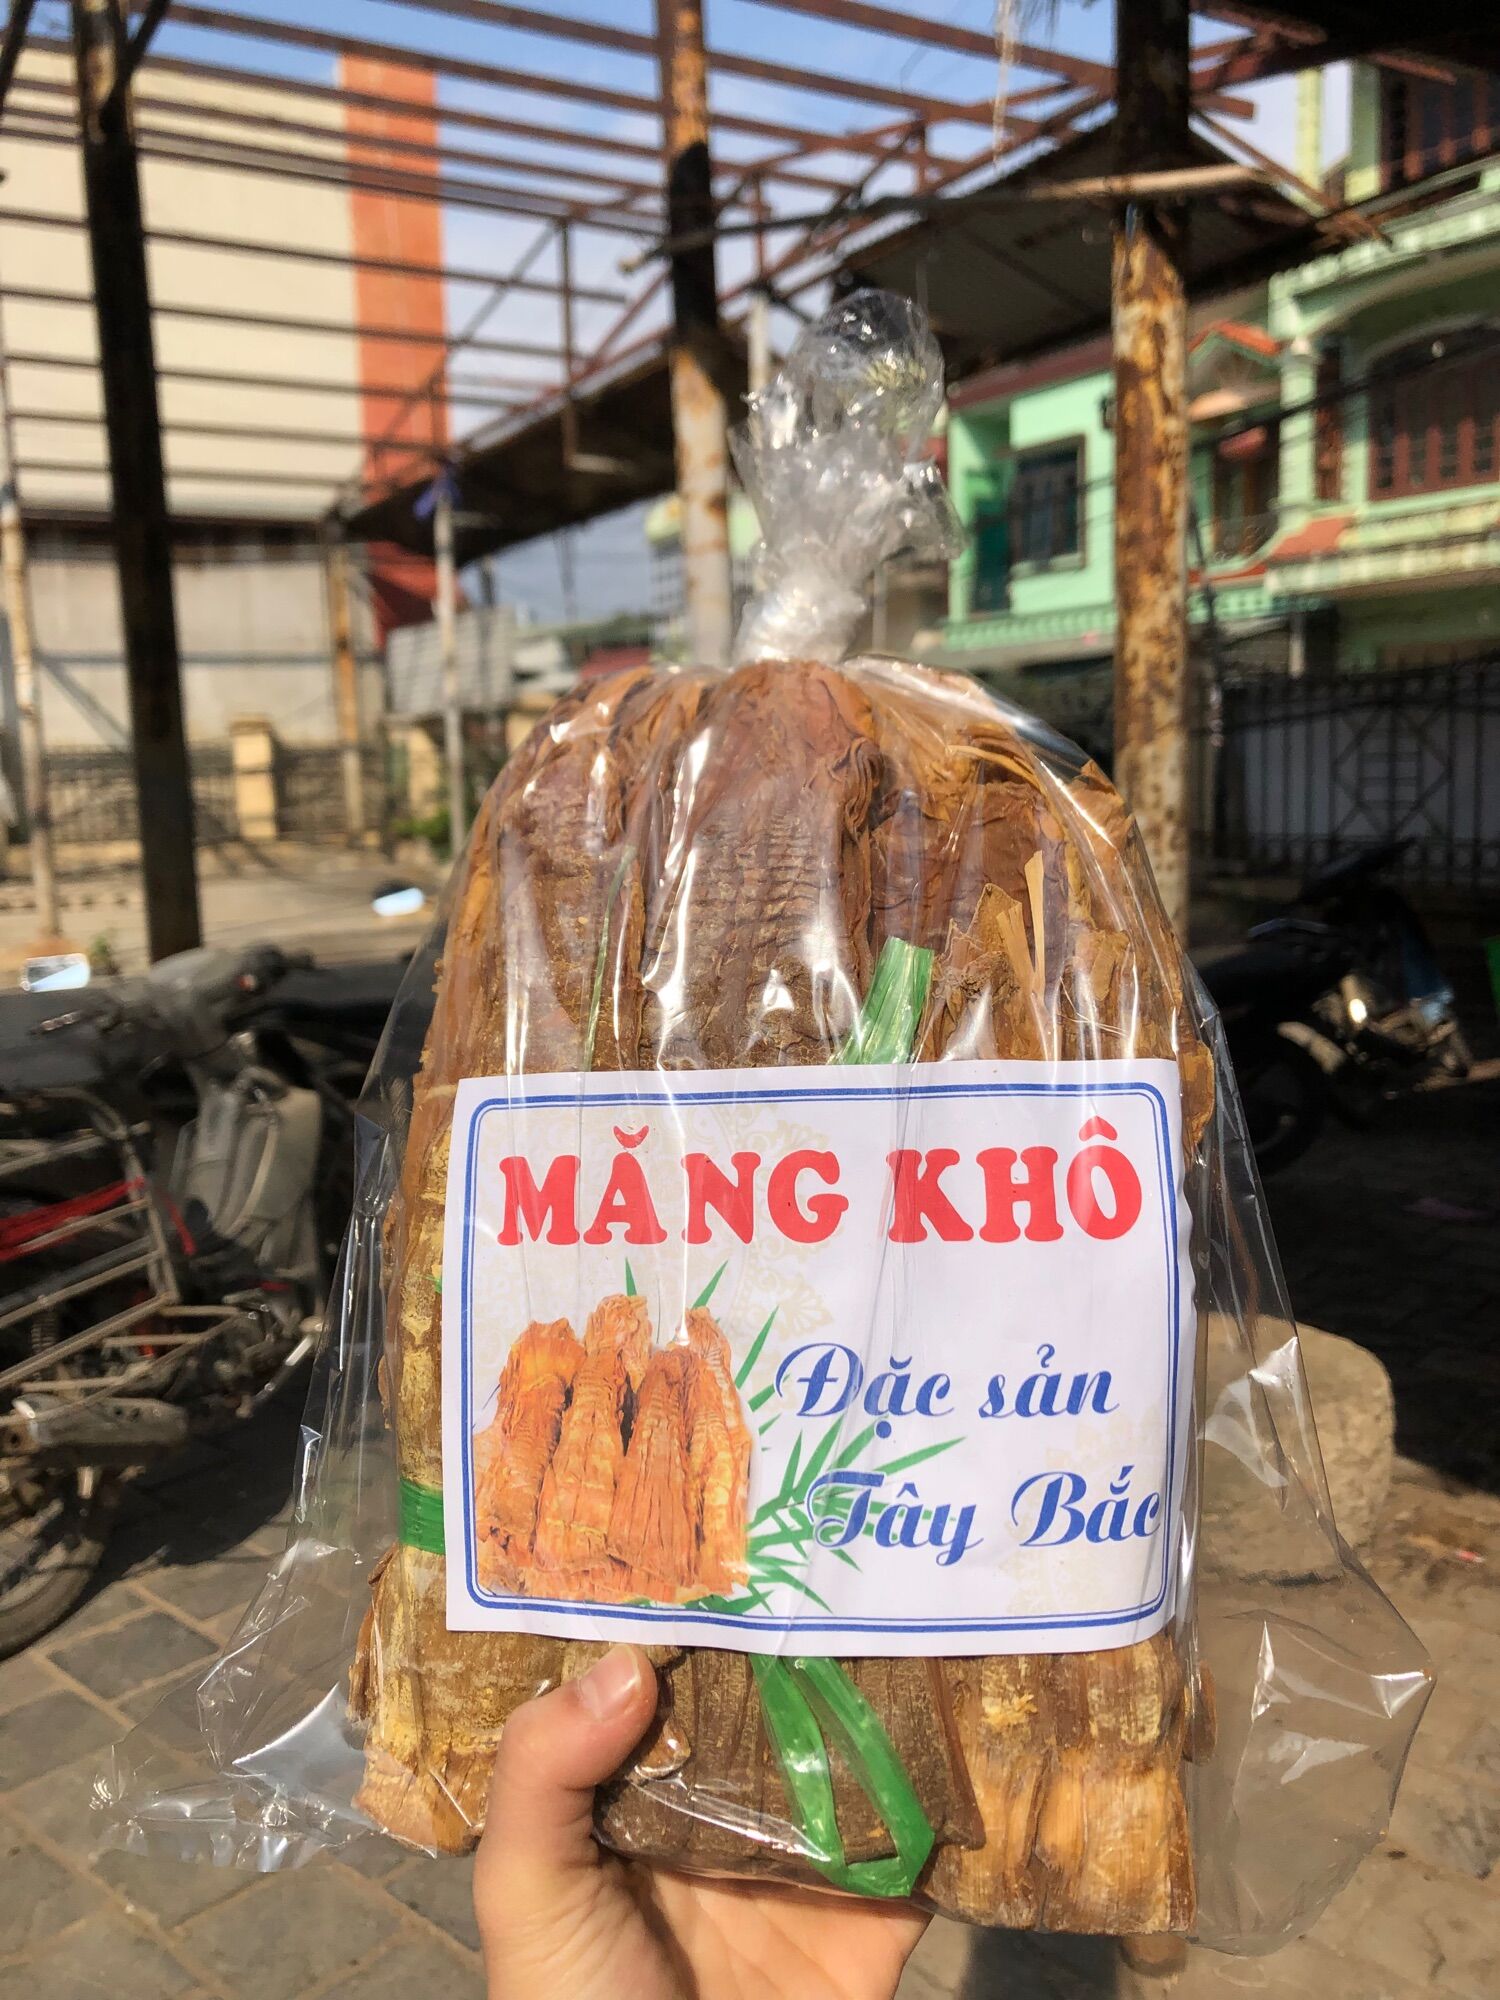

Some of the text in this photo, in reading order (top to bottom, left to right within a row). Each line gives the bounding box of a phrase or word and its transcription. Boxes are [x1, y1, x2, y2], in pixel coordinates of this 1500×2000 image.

[498, 1115, 1143, 1246] MĂNG KHÔ
[775, 1342, 1120, 1439] Đặc sản
[807, 1465, 1162, 1567] Tây Bắc
